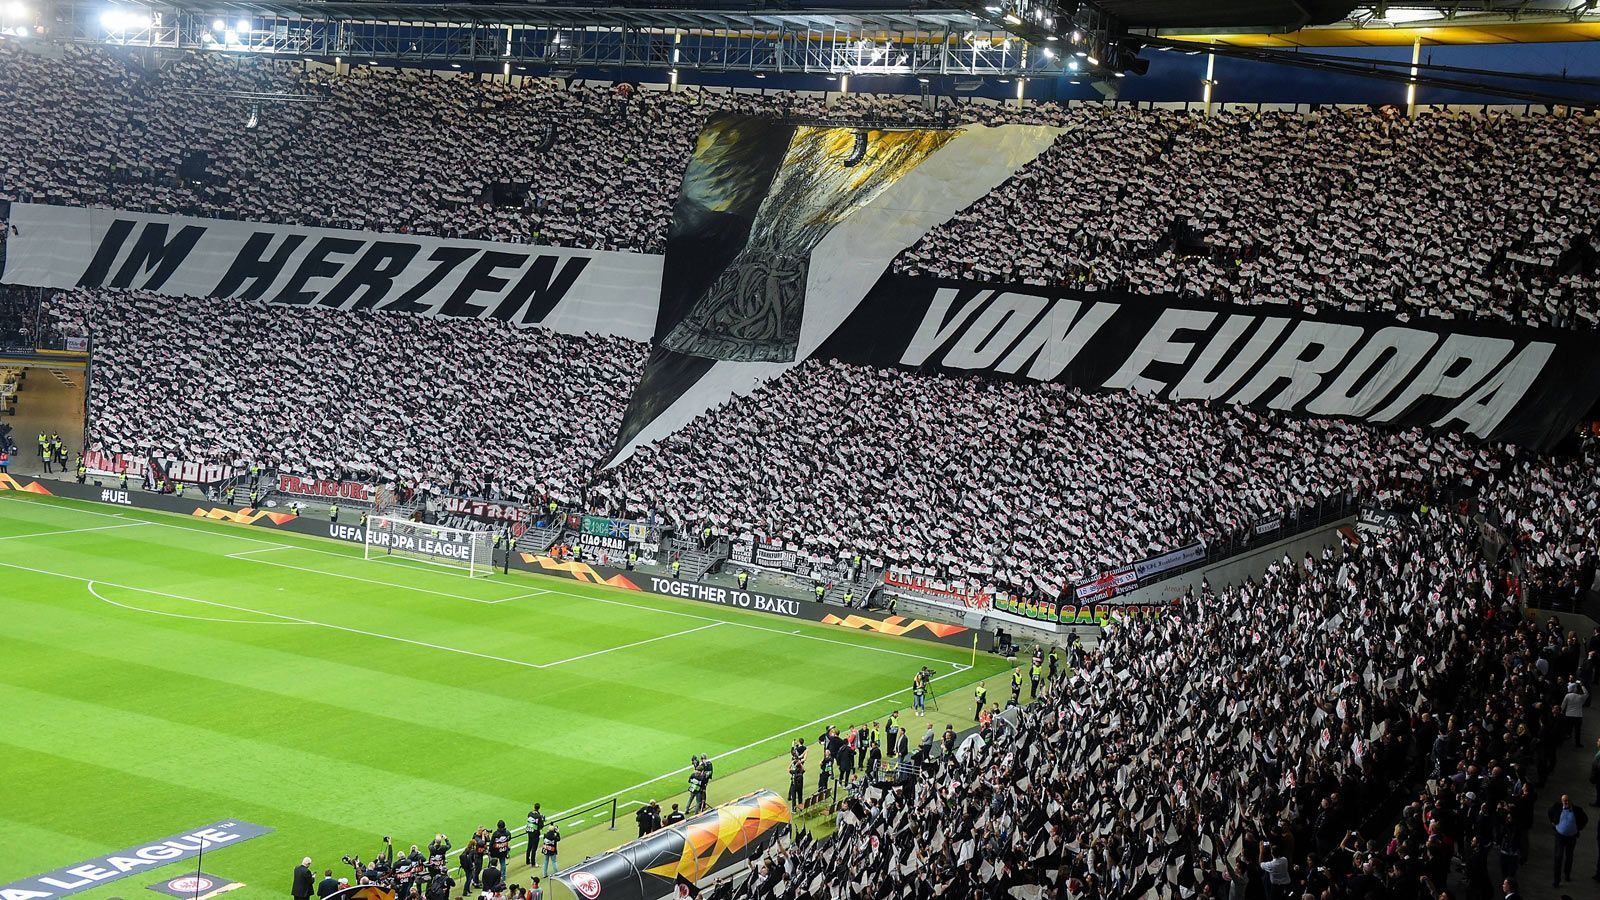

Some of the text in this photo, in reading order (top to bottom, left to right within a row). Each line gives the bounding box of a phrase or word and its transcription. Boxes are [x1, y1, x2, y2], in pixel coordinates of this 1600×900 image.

[76, 219, 590, 323] IM HERZEN
[899, 288, 1555, 438] VON EUROPA
[101, 489, 132, 504] #UEL
[329, 524, 470, 559] UEFA EUROPA LEAGUE
[651, 577, 800, 616] TOGETHER TO BAKU
[889, 571, 975, 597] EINTRCHT
[38, 828, 241, 890] LEAGUE
